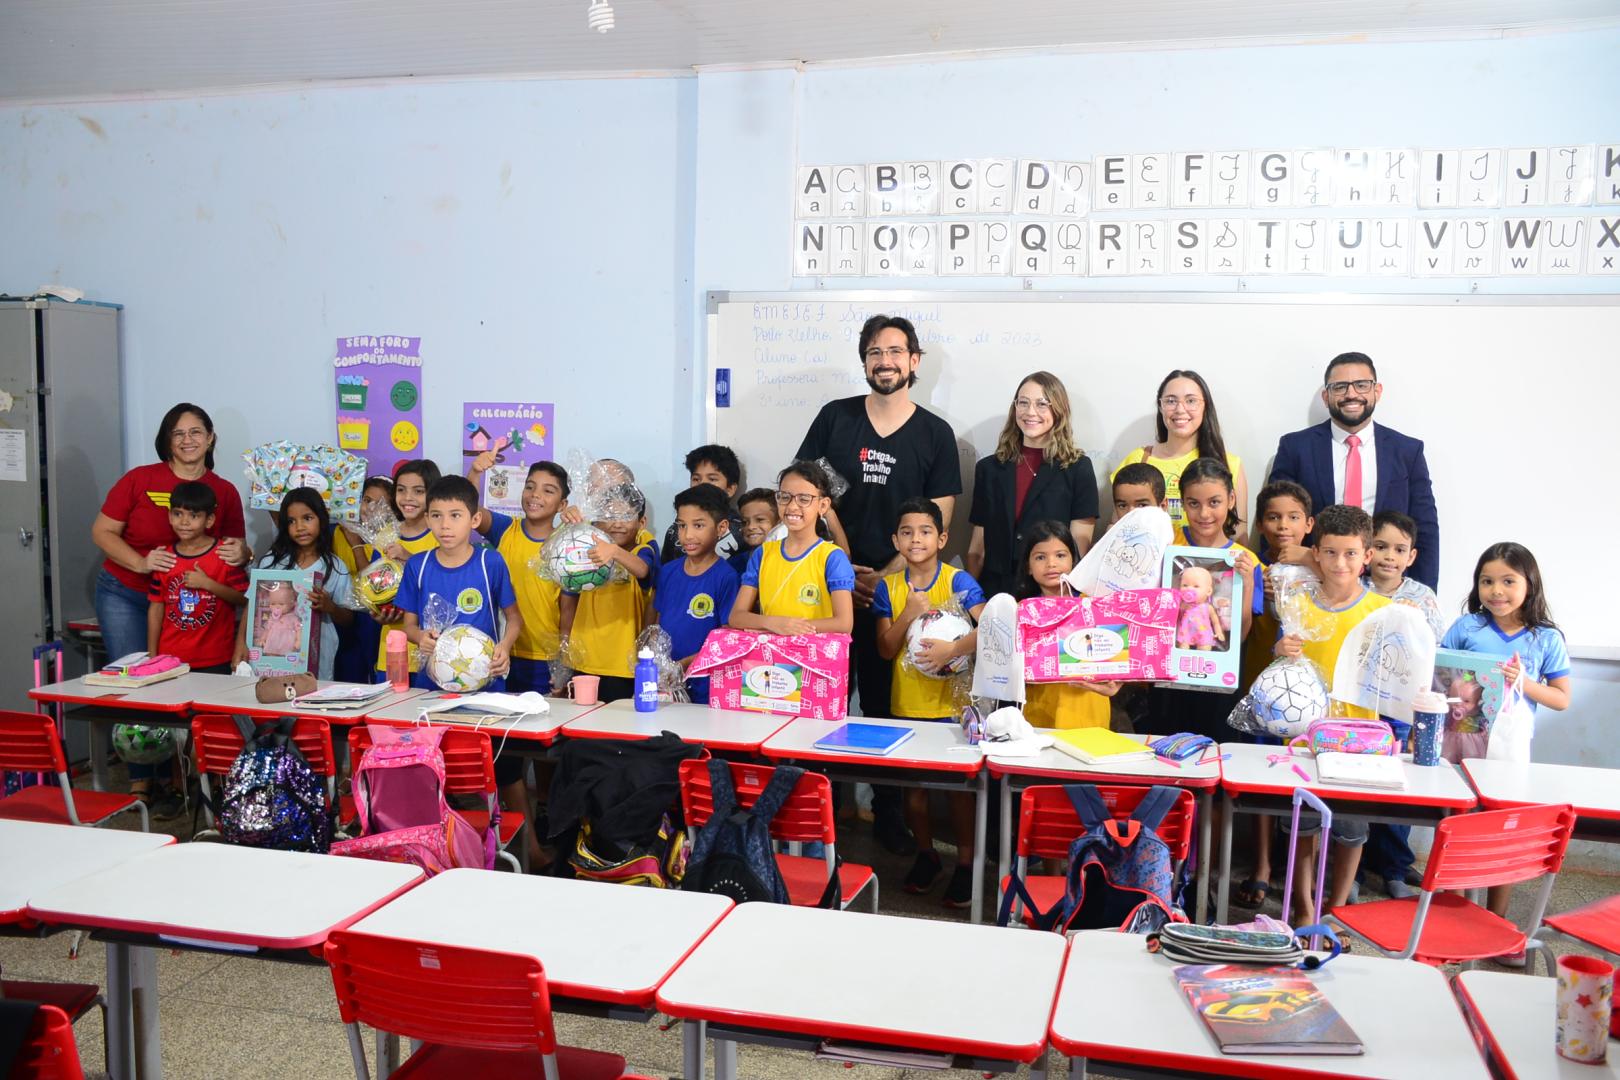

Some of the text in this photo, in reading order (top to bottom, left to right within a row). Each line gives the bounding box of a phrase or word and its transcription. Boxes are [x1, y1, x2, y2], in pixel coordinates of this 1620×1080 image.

[804, 168, 827, 194] A
[877, 166, 898, 192] B
[950, 163, 973, 190] C
[1026, 163, 1050, 189] D
[1104, 158, 1125, 185] E
[1184, 154, 1204, 181] F
[1260, 153, 1287, 182] G
[1436, 153, 1443, 181] I
[1516, 150, 1537, 180] J
[810, 201, 819, 212] a
[882, 197, 892, 212] b
[956, 196, 965, 208] c
[1028, 195, 1040, 210] d
[1108, 191, 1118, 204] e
[1188, 187, 1196, 202] f
[1267, 188, 1279, 202] g
[1350, 186, 1360, 200] h
[1436, 188, 1440, 203] i
[1521, 184, 1528, 204] j
[802, 226, 823, 251] N
[874, 225, 898, 252] O
[950, 224, 970, 250] P
[1020, 224, 1046, 252] Q
[1099, 224, 1122, 251] R
[1177, 221, 1199, 249] S
[1258, 221, 1281, 249] T
[1339, 220, 1362, 248] U
[1423, 221, 1447, 249] V
[1504, 220, 1541, 248] W
[1597, 218, 1620, 247] X
[808, 256, 817, 269] n
[880, 257, 890, 269] o
[954, 254, 964, 269] p
[1027, 256, 1038, 270] q
[1106, 256, 1114, 269] r
[1183, 256, 1193, 268] s
[1264, 253, 1271, 268] t
[1344, 255, 1354, 268] u
[1428, 256, 1438, 268] v
[1511, 256, 1528, 269] w
[1602, 256, 1613, 269] x
[334, 353, 422, 367] COMPORTAMENTO
[472, 404, 543, 418] CALENDÁRIO
